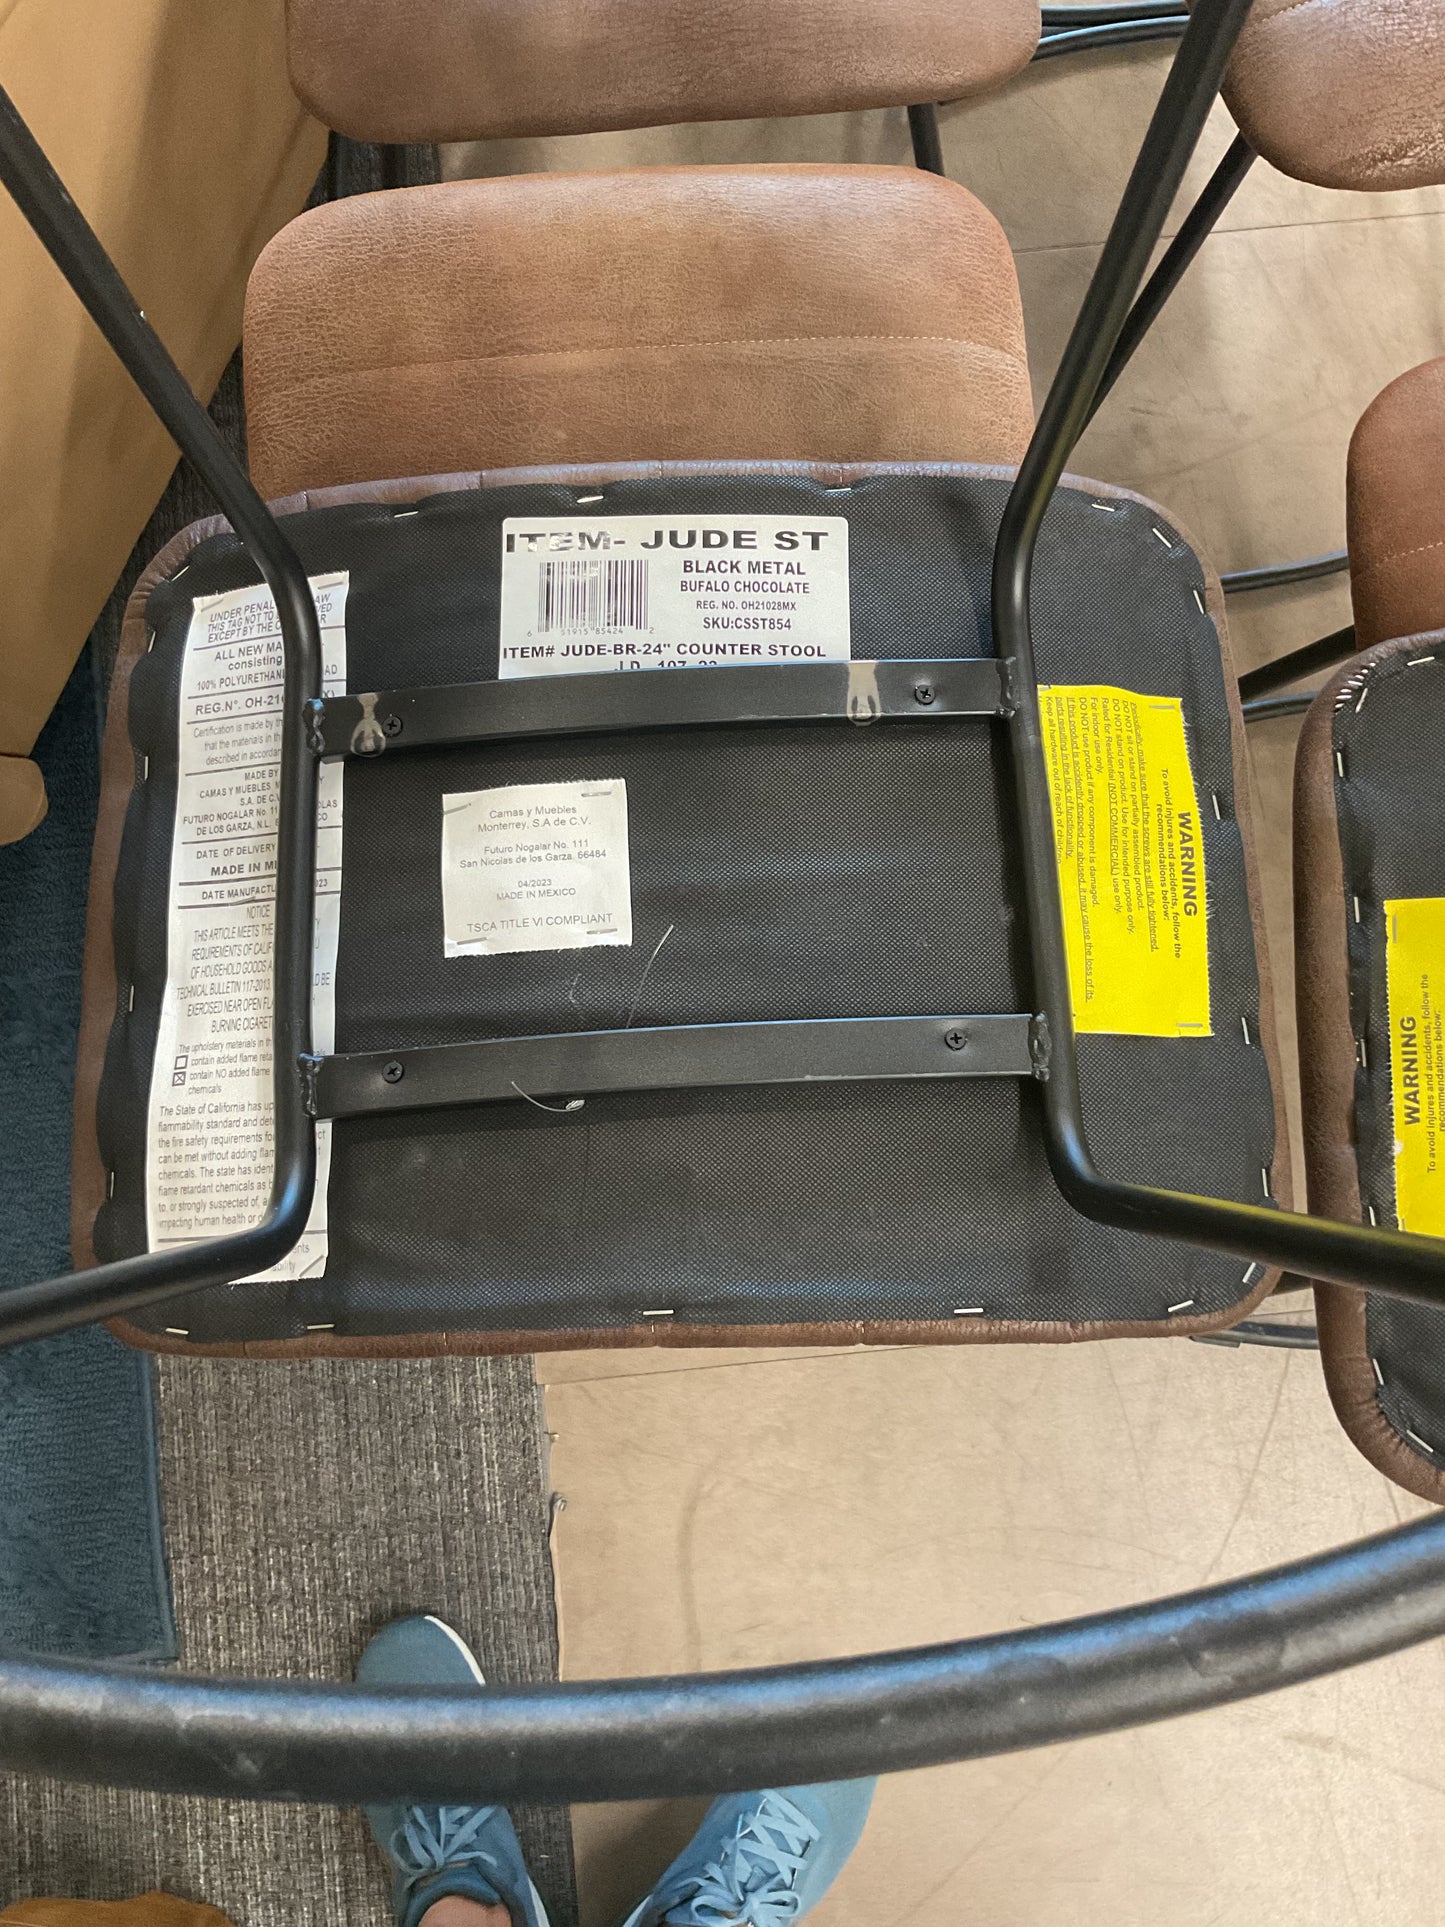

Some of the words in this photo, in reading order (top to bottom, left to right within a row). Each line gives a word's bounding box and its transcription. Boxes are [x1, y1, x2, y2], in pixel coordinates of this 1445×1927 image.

[506, 532, 626, 552] ITEM-
[641, 530, 757, 550] JUDE
[775, 530, 828, 551] ST
[683, 560, 741, 574] BLACK
[748, 561, 806, 575] METAL
[680, 580, 730, 593] BUFALO
[734, 580, 810, 594] CHOCOLATE
[696, 600, 718, 610] REG.
[722, 600, 738, 610] NO.
[741, 600, 796, 611] OH21028MX
[208, 622, 225, 632] THIS
[228, 617, 242, 628] TAG
[245, 613, 261, 624] NOT
[264, 611, 274, 621] TO
[210, 608, 242, 621] UNDER
[703, 617, 791, 630] SKU:CSST854
[208, 628, 240, 643] EXCEPT
[241, 625, 254, 636] BY
[256, 622, 273, 633] THE
[214, 650, 235, 661] ALL
[238, 644, 264, 657] NEW
[503, 645, 555, 659] ITEM#
[676, 643, 762, 656] COUNTER
[768, 644, 826, 657] STOOL
[228, 655, 282, 670] consisting
[1102, 697, 1110, 721] Rated
[1112, 698, 1120, 712] DO
[1122, 700, 1130, 714] DO
[1114, 714, 1123, 733] NOT
[1124, 715, 1133, 734] NOT
[1116, 734, 1124, 757] stand
[1127, 746, 1134, 755] or
[1105, 736, 1116, 781] Residential
[1118, 759, 1124, 769] on
[245, 770, 266, 780] MADE
[268, 769, 279, 778] BY
[1128, 757, 1137, 780] stand
[1161, 769, 1168, 778] To
[200, 788, 226, 799] CAMAS
[229, 787, 234, 795] Y
[236, 782, 271, 794] MUEBLES
[1130, 782, 1136, 792] on
[1163, 781, 1172, 805] avoid
[257, 795, 267, 804] DE
[1082, 750, 1093, 780] product
[1088, 806, 1096, 854] component
[183, 814, 215, 824] FUTURO
[217, 809, 254, 821] NOGALAR
[489, 810, 524, 819] Camas
[527, 809, 532, 818] y
[535, 806, 576, 815] Muebles
[1121, 807, 1129, 824] Use
[1130, 794, 1140, 827] partially
[554, 817, 566, 826] de
[1164, 808, 1174, 839] injures
[197, 827, 206, 836] DE
[209, 825, 224, 834] LOS
[196, 849, 219, 859] DATE
[223, 847, 234, 857] OF
[237, 842, 276, 855] DELIVERY
[484, 846, 513, 855] Futuro
[516, 843, 551, 853] Nogalar
[573, 839, 588, 848] 111
[1133, 829, 1141, 875] assembled
[1156, 804, 1167, 887] recommendations
[1168, 842, 1176, 859] and
[460, 860, 478, 868] San
[481, 857, 513, 866] Nicolas
[516, 855, 527, 864] de
[529, 854, 543, 862] los
[578, 849, 606, 859] 66484
[1122, 840, 1130, 877] intended
[1178, 812, 1197, 916] WARNING
[211, 864, 244, 876] MADE
[249, 862, 261, 872] IN
[518, 879, 552, 888] 04/2023
[1169, 862, 1178, 909] accidents,
[202, 890, 224, 900] DATE
[496, 891, 523, 901] MADE
[526, 890, 536, 898] IN
[538, 888, 576, 897] MEXICO
[1123, 879, 1132, 912] purpose
[1161, 890, 1170, 920] below:
[467, 922, 497, 932] TSCA
[500, 918, 529, 929] TITLE
[532, 917, 543, 927] VI
[546, 913, 612, 926] COMPLIANT
[1172, 912, 1180, 941] follow
[1174, 944, 1182, 958] the
[1420, 974, 1429, 989] the
[1421, 991, 1430, 1019] follow
[1433, 1010, 1442, 1041] below:
[1423, 1022, 1433, 1071] accidents,
[1400, 1017, 1420, 1124] WARNING
[1424, 1074, 1434, 1091] and
[1426, 1095, 1437, 1128] injures
[1427, 1131, 1436, 1158] avoid
[1427, 1161, 1436, 1173] To
